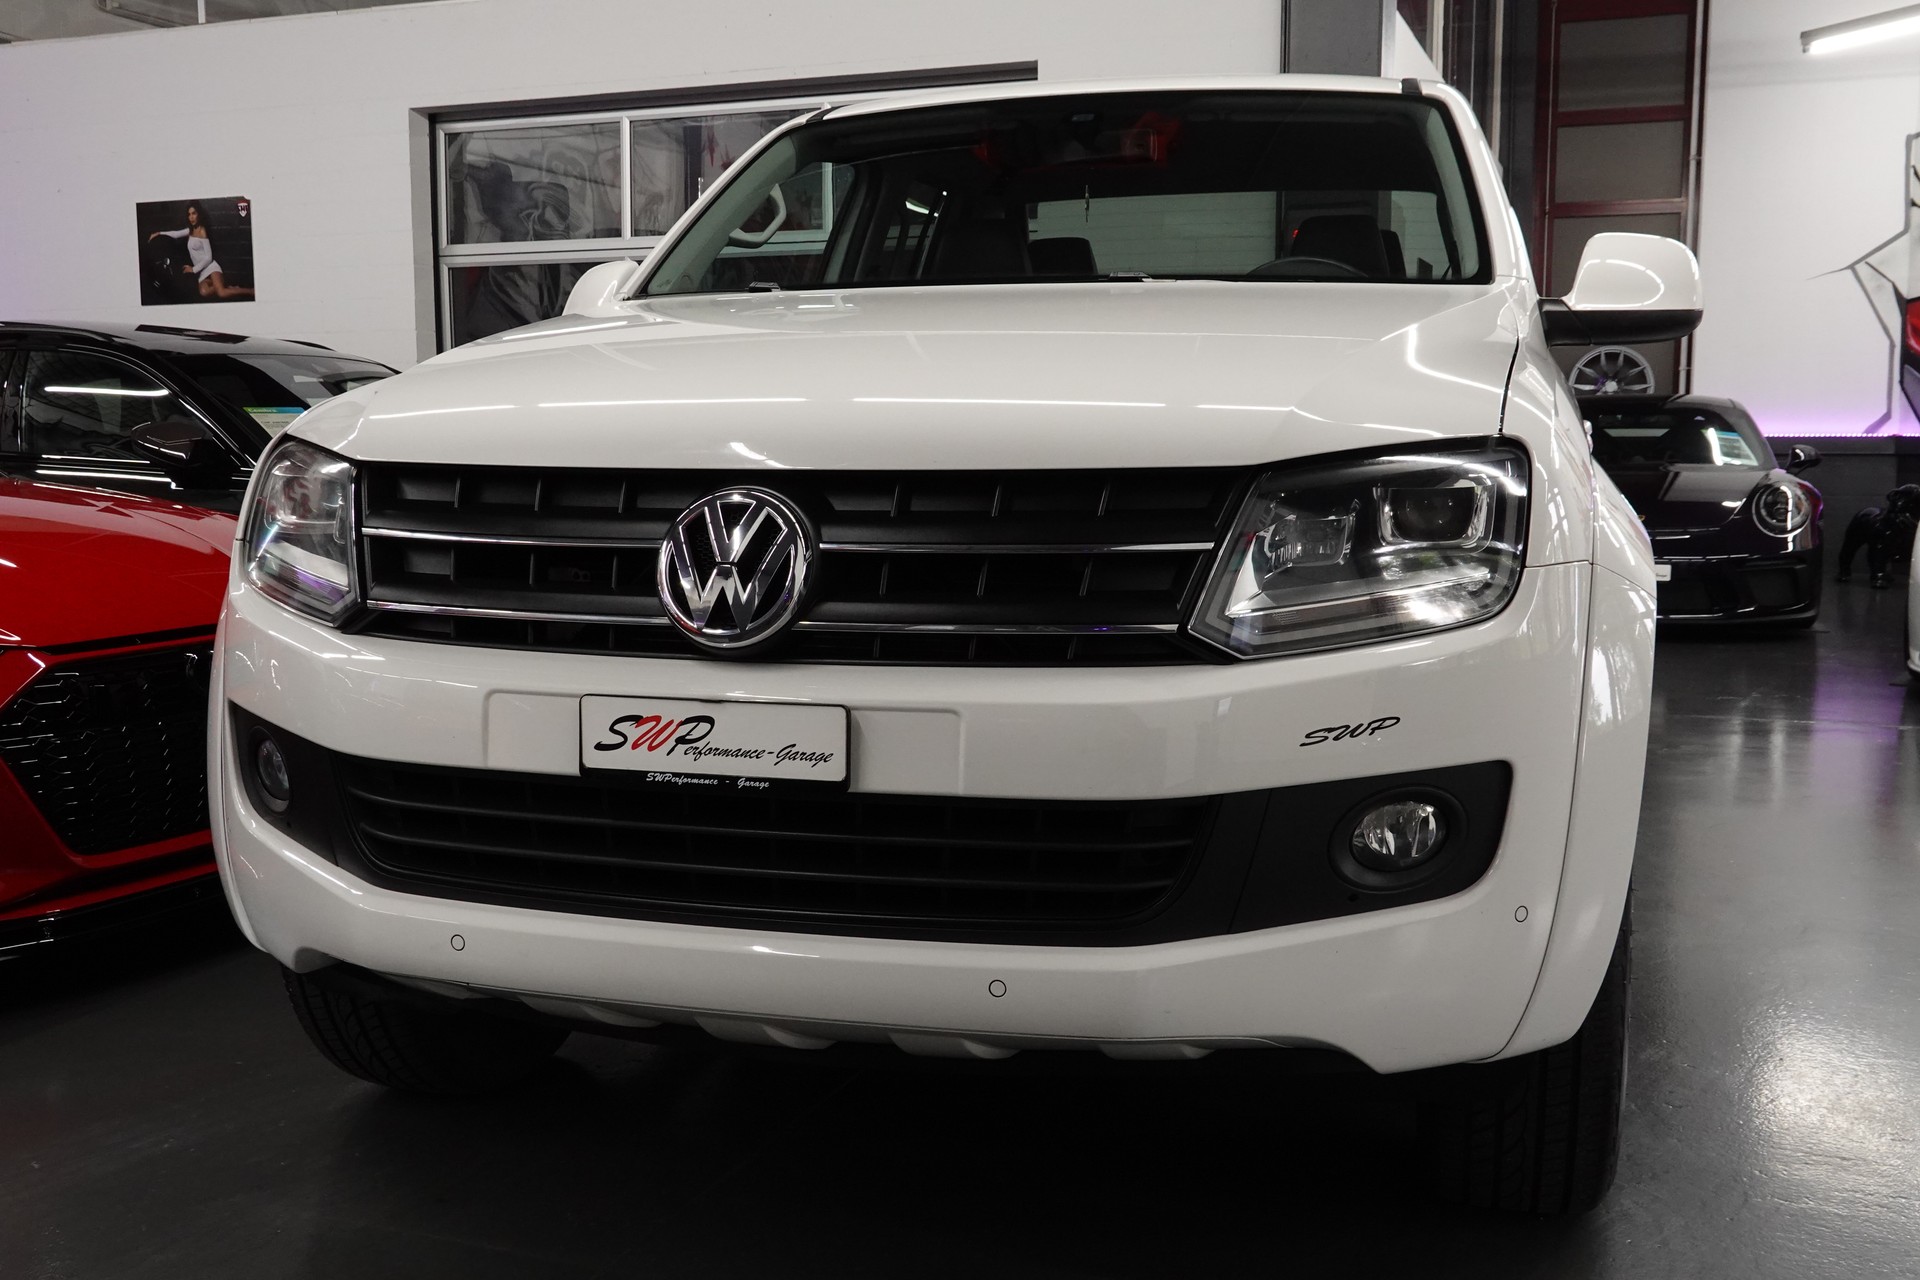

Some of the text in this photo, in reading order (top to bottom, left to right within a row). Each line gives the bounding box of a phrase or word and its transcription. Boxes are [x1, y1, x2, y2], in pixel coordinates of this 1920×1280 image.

[660, 489, 807, 643] VW
[1299, 716, 1401, 747] SWP
[645, 772, 719, 786] SWPerformance
[737, 777, 770, 790] Garage
